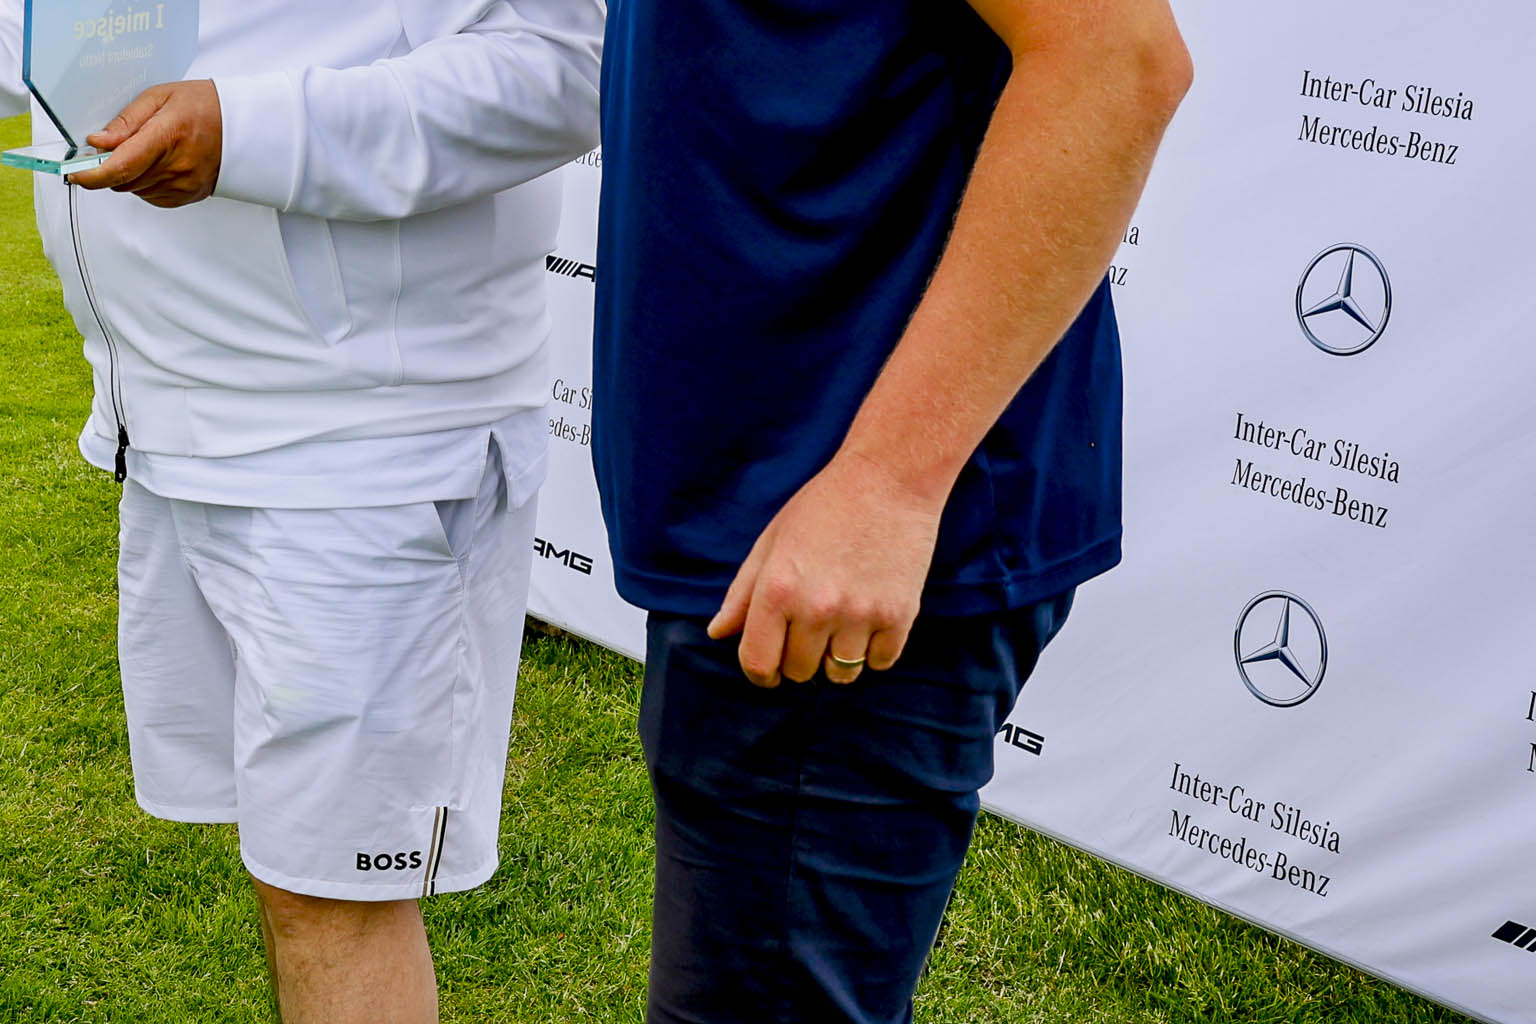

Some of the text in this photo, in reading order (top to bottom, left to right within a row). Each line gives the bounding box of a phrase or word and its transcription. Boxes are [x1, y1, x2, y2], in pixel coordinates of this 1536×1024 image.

[1300, 70, 1473, 120] Inter-Car Silesia
[1298, 115, 1458, 164] Mercedes-Benz
[1234, 413, 1399, 483] Inter-Car Silesia
[1231, 459, 1388, 528] Mercedes-Benz
[1170, 763, 1340, 854] Inter-Car Silesia
[356, 851, 422, 872] BOSS
[1169, 810, 1330, 897] Mercedes-Benz
